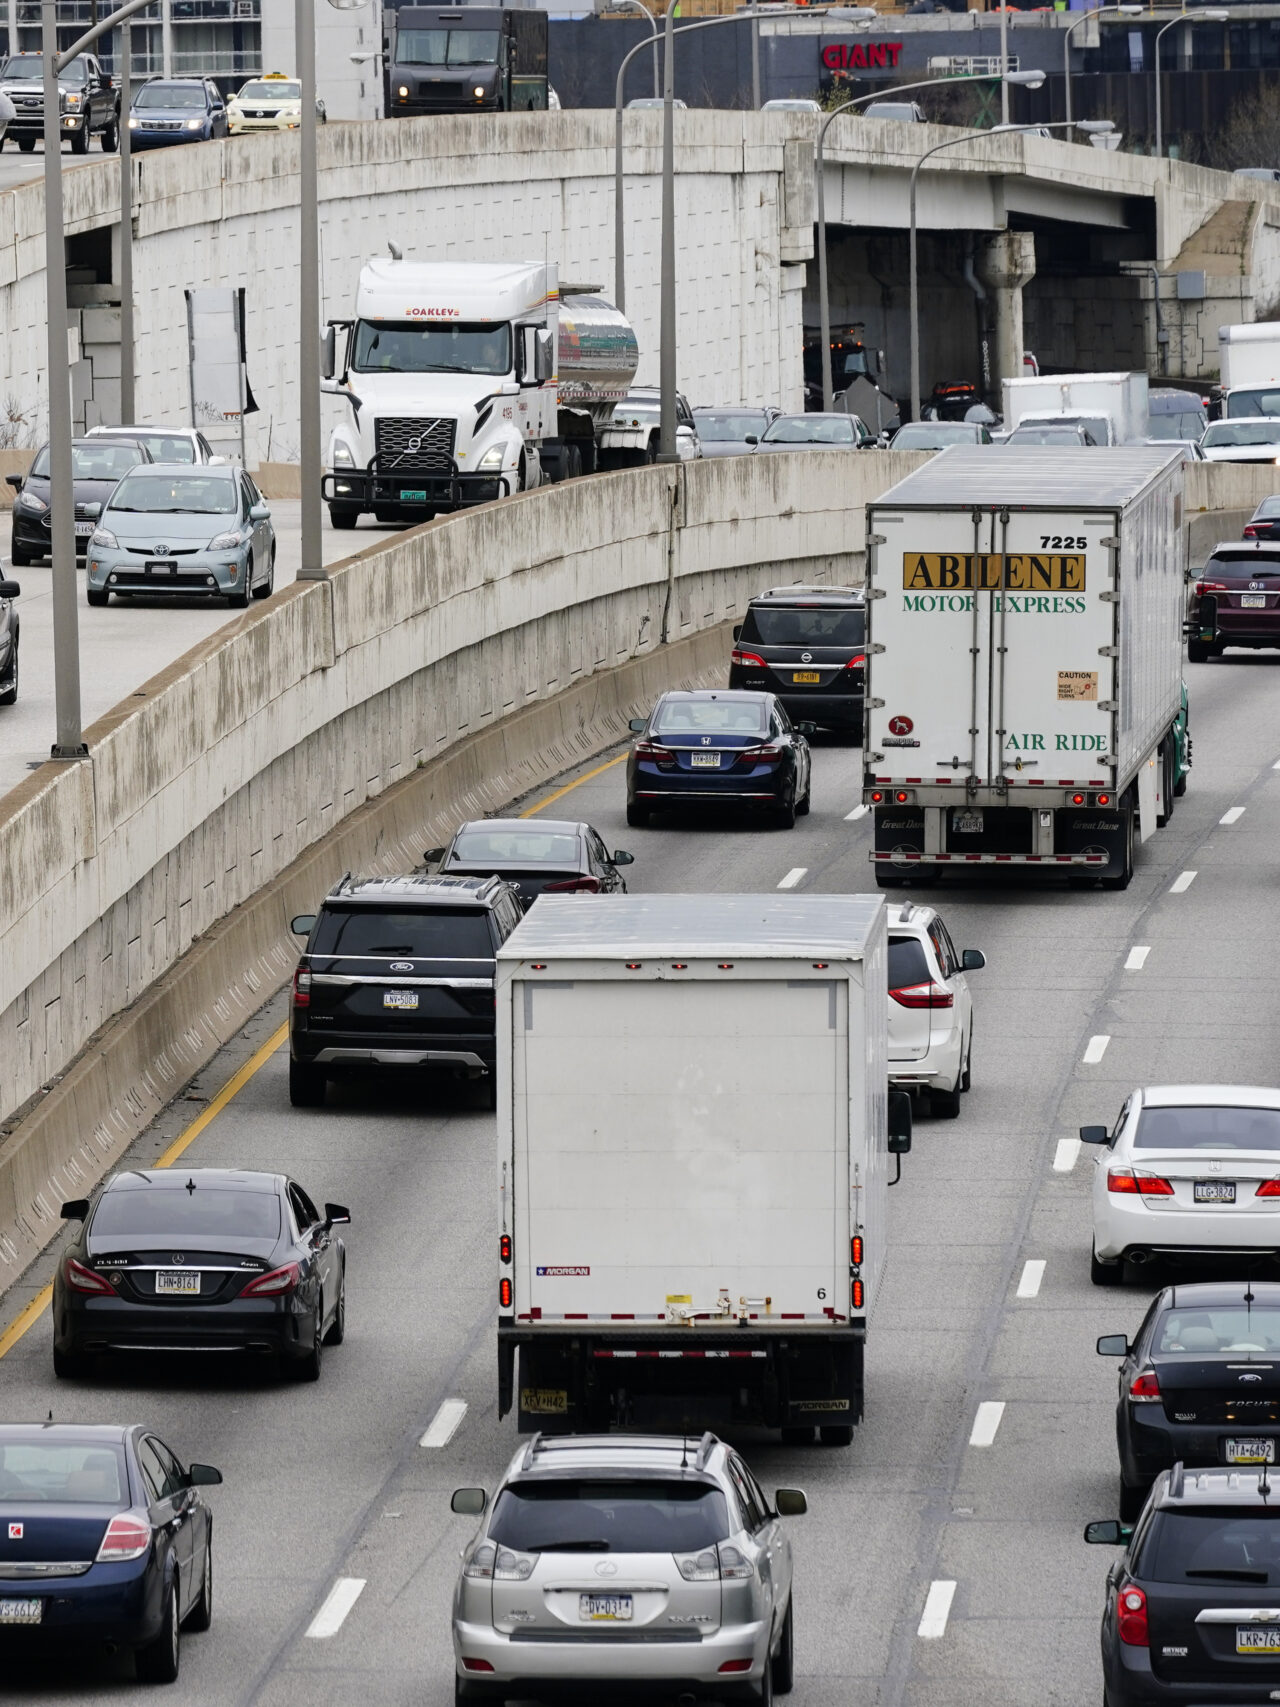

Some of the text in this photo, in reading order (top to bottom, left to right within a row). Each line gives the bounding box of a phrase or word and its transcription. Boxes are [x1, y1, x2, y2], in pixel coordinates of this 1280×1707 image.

[823, 43, 903, 68] GIANT
[411, 308, 454, 316] OAKLEY
[1040, 536, 1088, 549] 7225
[908, 554, 1082, 589] ABILENE
[902, 595, 1087, 613] MOTOR EXPRESS
[1059, 671, 1092, 679] CAUTION
[1005, 733, 1108, 751] AIR RIDE
[881, 820, 925, 829] Great Dan
[817, 1288, 826, 1299] 6
